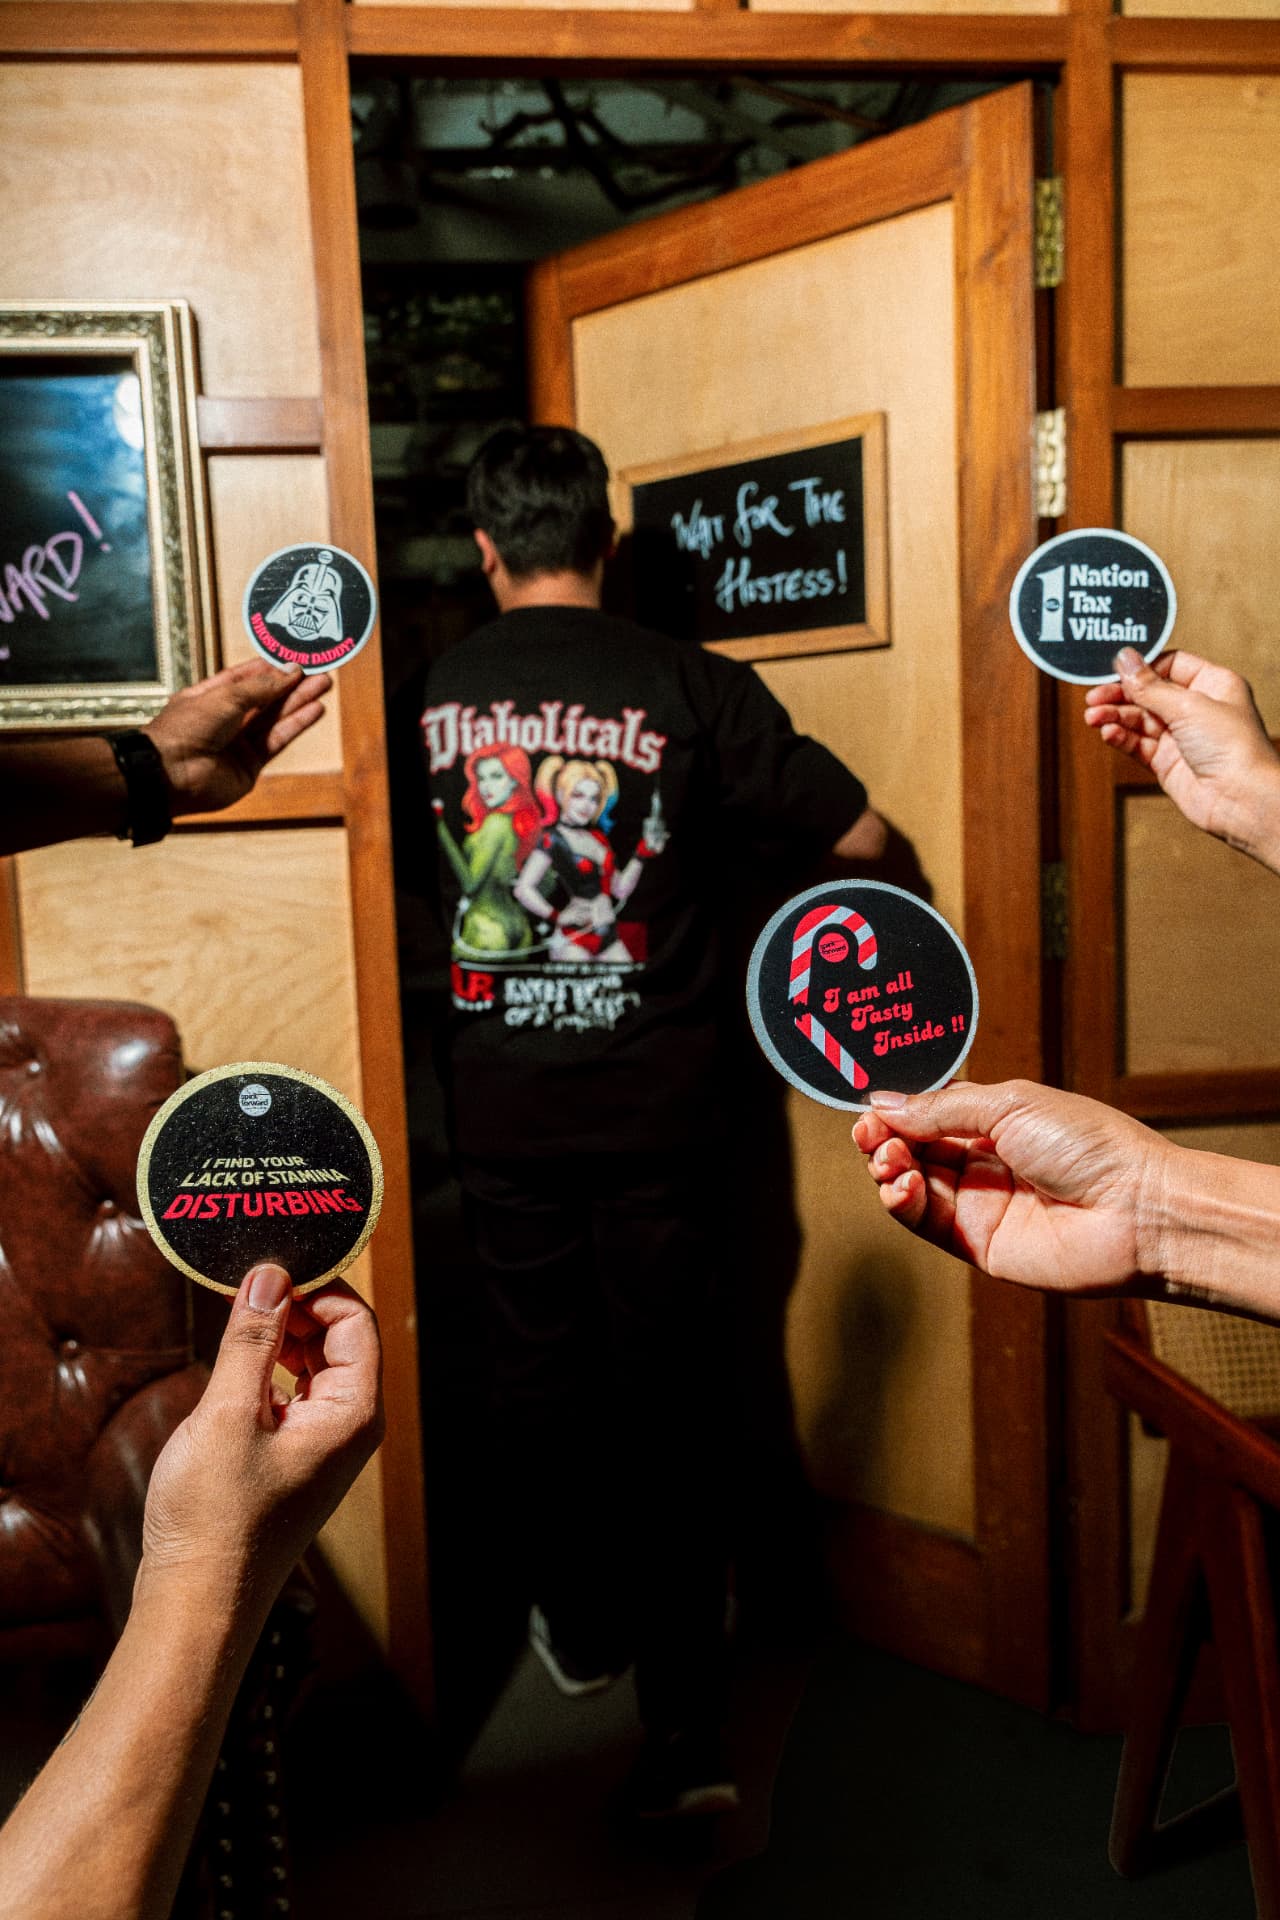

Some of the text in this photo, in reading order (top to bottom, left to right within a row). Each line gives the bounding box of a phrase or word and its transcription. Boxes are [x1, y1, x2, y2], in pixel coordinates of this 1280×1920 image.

[1069, 563, 1150, 588] Nation
[1036, 565, 1066, 642] 1
[1068, 590, 1113, 614] Tax
[251, 612, 355, 665] WHOSE YOUR DADDY?
[1068, 617, 1148, 642] Villain
[823, 970, 914, 1013] I am all
[850, 1002, 914, 1031] Tasty
[872, 1020, 946, 1056] Inside
[201, 1155, 310, 1169] I FIND YOUR
[177, 1168, 351, 1187] LACK OF STAMINA
[162, 1189, 363, 1219] DISTURBING
